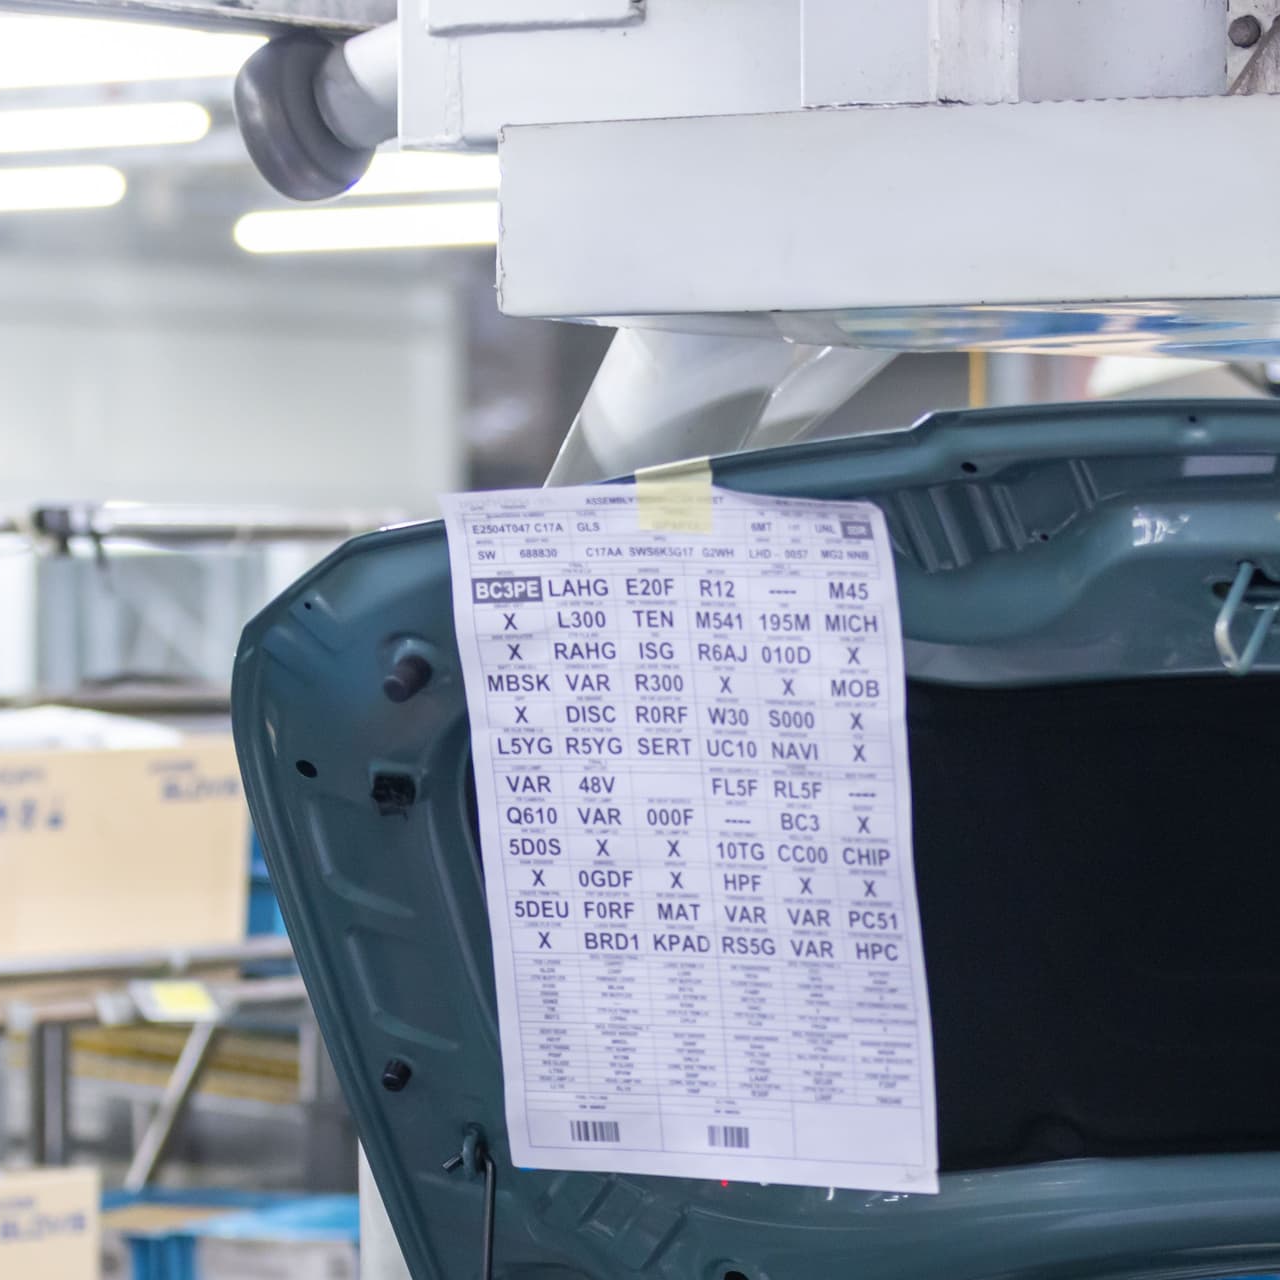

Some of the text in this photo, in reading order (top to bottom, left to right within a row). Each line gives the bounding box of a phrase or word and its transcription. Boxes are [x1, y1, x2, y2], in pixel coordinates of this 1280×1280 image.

[534, 523, 563, 532] C17A
[577, 522, 600, 532] GLS
[478, 551, 495, 560] SW
[749, 549, 771, 559] LHD
[476, 582, 540, 600] BC3PE
[548, 579, 608, 597] LAHG
[626, 578, 673, 596] E20F
[700, 579, 734, 598] R12
[829, 582, 868, 600] M45
[504, 610, 877, 632] X L300 TEN M541 195M MICH
[508, 644, 522, 660] X
[554, 642, 616, 659] RAHG
[639, 642, 674, 660] ISG
[698, 643, 747, 662] R6AJ
[848, 647, 860, 664] X
[488, 674, 879, 698] MBSK VAR R300 X X MOB
[515, 707, 528, 723] X
[566, 706, 615, 723] DISC
[708, 708, 749, 726] W30
[851, 713, 863, 730] X
[498, 737, 866, 762] L5YG R5YG SERT UC10 NAVI X
[506, 776, 551, 792] VAR
[579, 776, 615, 793] 48V
[712, 778, 757, 796] FL5F
[774, 780, 822, 799] RL5F
[507, 807, 557, 825] Q610
[578, 808, 621, 824] VAR
[781, 813, 820, 831] BC3
[858, 817, 870, 833] X
[597, 840, 609, 856] X
[668, 840, 680, 856] X
[717, 842, 764, 861] 10TG
[843, 848, 890, 866] CHIP
[532, 870, 545, 886] X
[671, 872, 683, 888] X
[724, 874, 760, 892] HPF
[800, 878, 812, 894] X
[864, 880, 876, 897] X
[515, 901, 568, 918] 5DEU
[658, 903, 700, 920] MAT
[725, 906, 766, 924] VAR
[788, 909, 830, 926] VAR
[849, 911, 897, 930] PC51
[539, 932, 898, 961] X BRD1 KPAD RS5G VAR HPC
